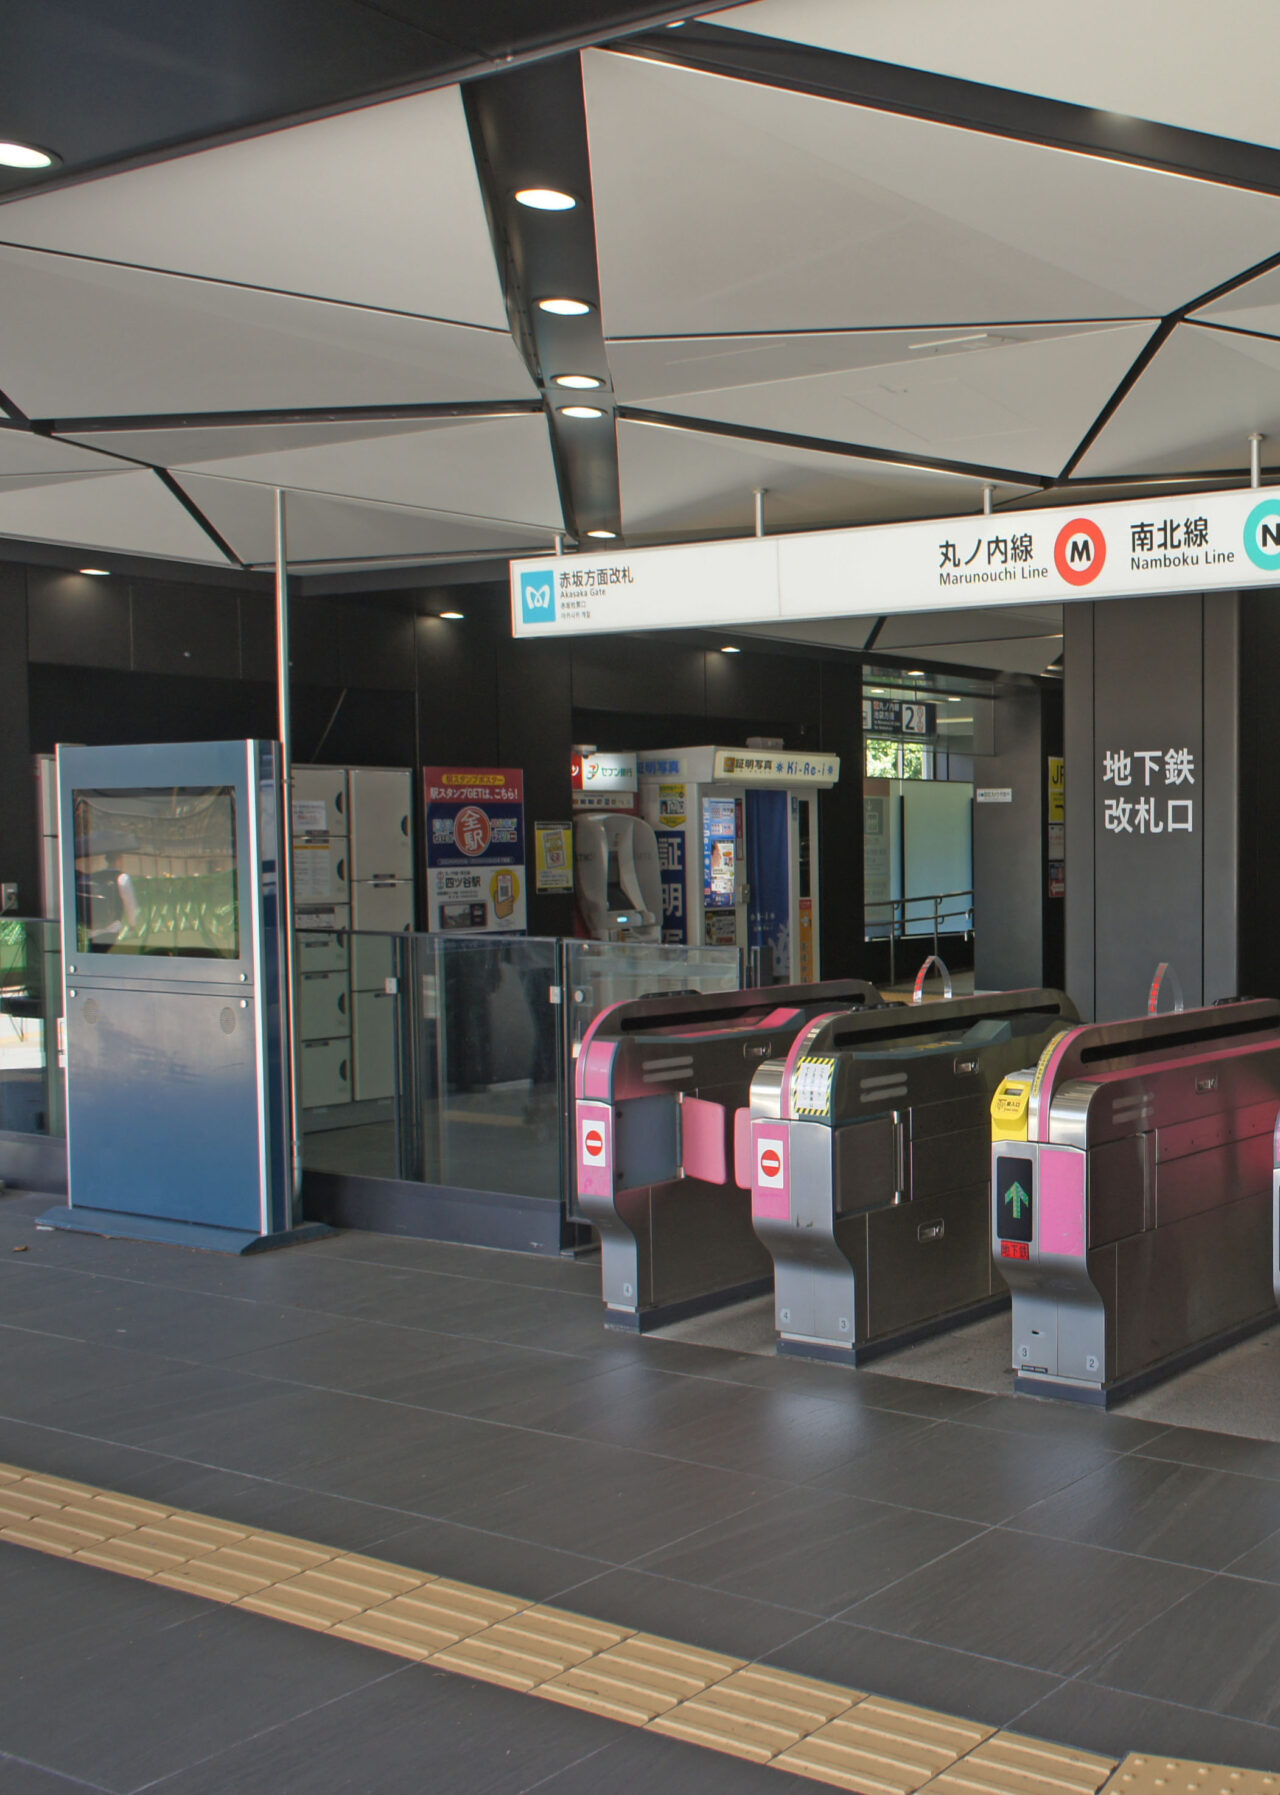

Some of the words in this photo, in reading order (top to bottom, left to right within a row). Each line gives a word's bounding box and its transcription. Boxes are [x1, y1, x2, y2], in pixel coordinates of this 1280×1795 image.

[1130, 516, 1209, 553] 南北線
[938, 533, 1034, 569] 丸ノ内線
[1069, 540, 1092, 563] M
[1130, 551, 1200, 571] Namboku
[1205, 549, 1235, 565] Line
[560, 566, 634, 589] 赤坂方面改札
[938, 567, 1017, 587] Marunouchi
[1021, 565, 1049, 581] Line
[560, 589, 588, 598] Akasaka
[590, 588, 606, 597] Gate
[905, 706, 915, 730] 2
[1102, 748, 1195, 787] 地下鉄
[1104, 796, 1193, 834] 改札口
[625, 1285, 631, 1294] 4
[783, 1311, 789, 1321] 4
[841, 1318, 847, 1329] 3
[1022, 1347, 1028, 1358] 3
[1089, 1358, 1095, 1369] 2
